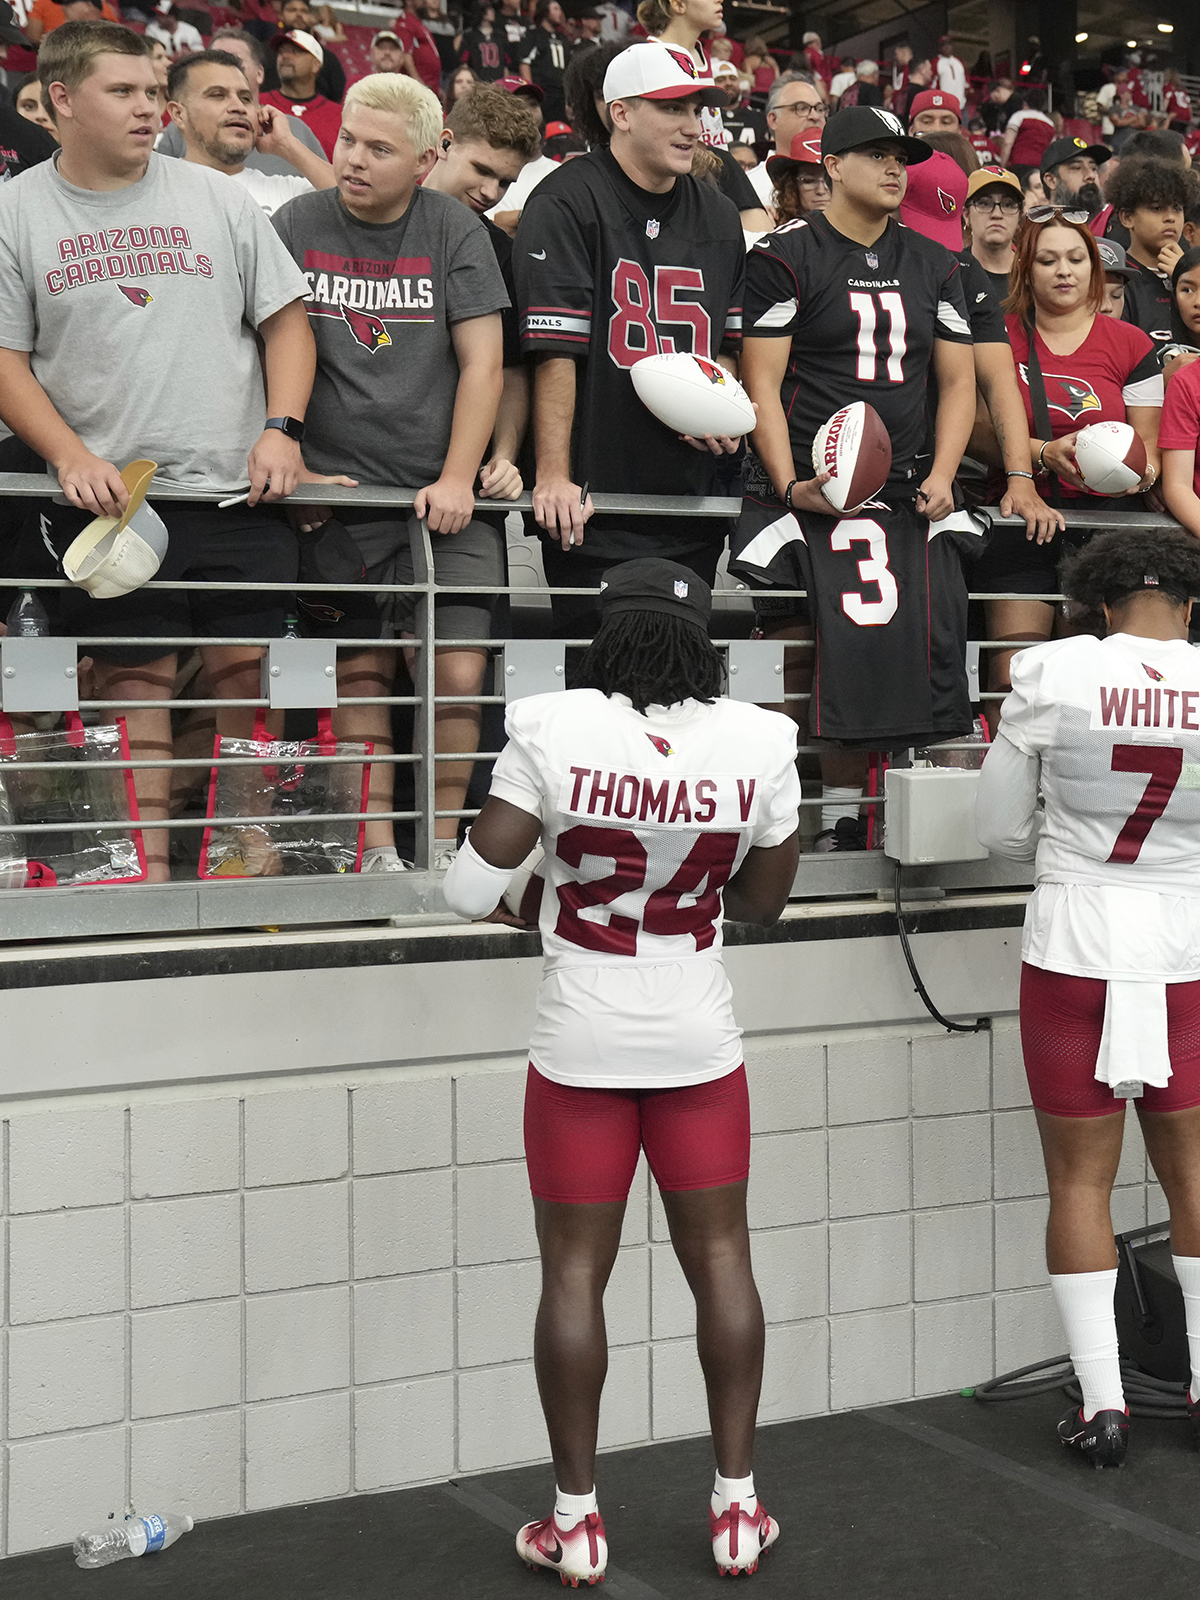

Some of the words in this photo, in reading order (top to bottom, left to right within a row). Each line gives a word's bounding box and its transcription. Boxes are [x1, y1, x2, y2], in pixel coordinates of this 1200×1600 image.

[44, 251, 214, 296] CARDINALS
[57, 224, 192, 263] ARIZONA
[302, 271, 434, 310] CARDINALS
[607, 257, 712, 370] 85
[848, 279, 900, 288] CARDINALS
[848, 291, 908, 383] 11
[824, 407, 852, 478] ARIZONA
[829, 517, 899, 627] 3
[1100, 686, 1200, 730] WHITE
[569, 766, 717, 823] THOMAS
[737, 778, 756, 822] V
[1105, 744, 1184, 864] 7
[554, 824, 741, 957] 24
